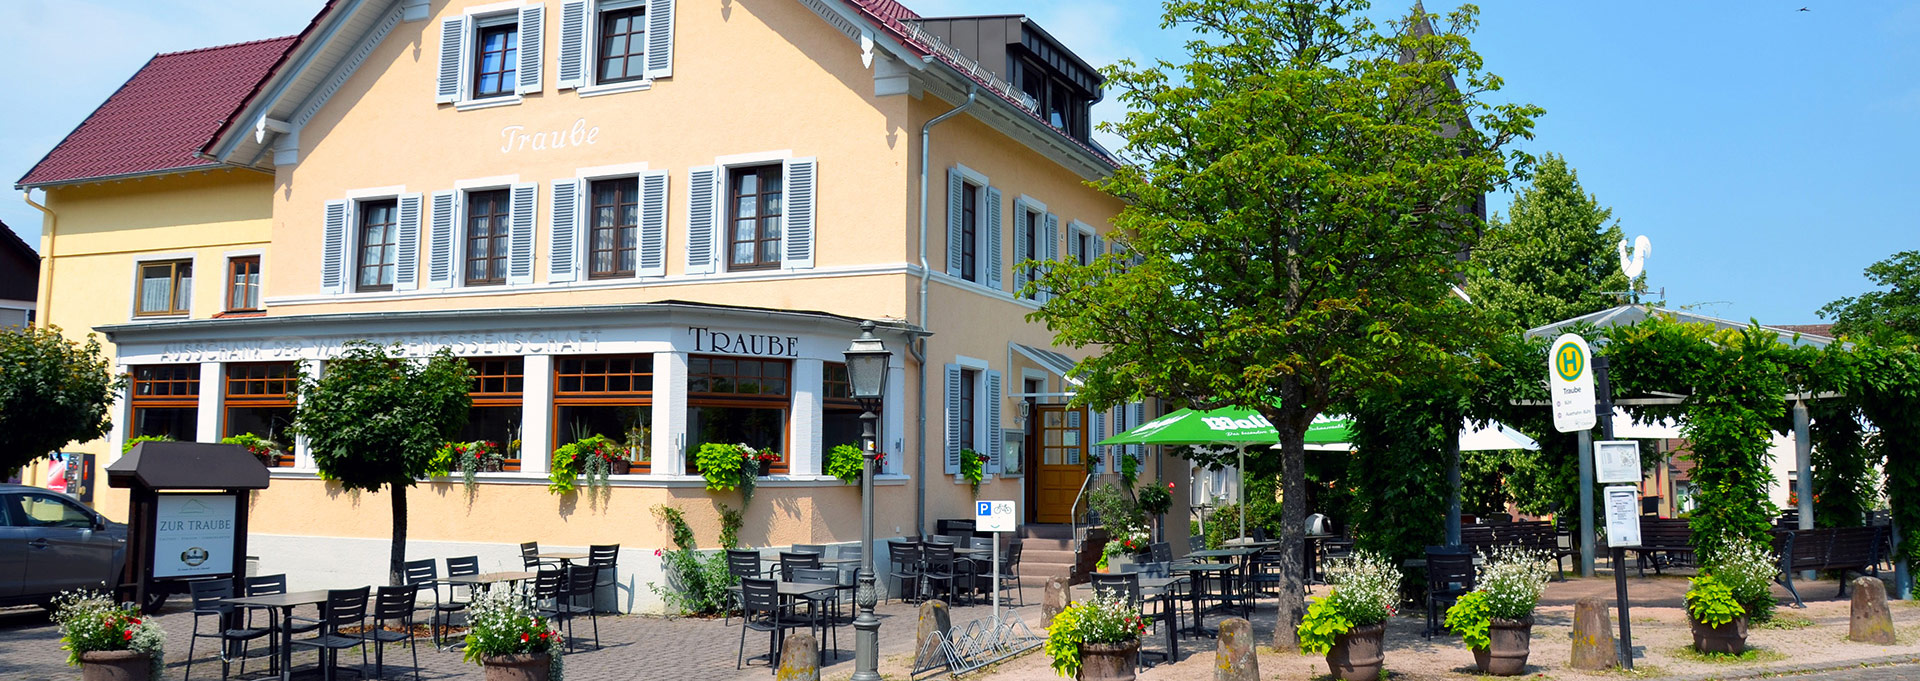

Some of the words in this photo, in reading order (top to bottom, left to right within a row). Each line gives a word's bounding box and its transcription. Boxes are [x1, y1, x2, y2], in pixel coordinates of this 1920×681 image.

[501, 118, 599, 153] Traube
[161, 340, 263, 362] AUSSCHANK
[272, 339, 302, 357] DER
[1563, 351, 1577, 373] H
[1563, 386, 1582, 395] Traube
[980, 503, 989, 514] P
[159, 520, 184, 532] ZUR
[188, 519, 231, 531] TRAUBE
